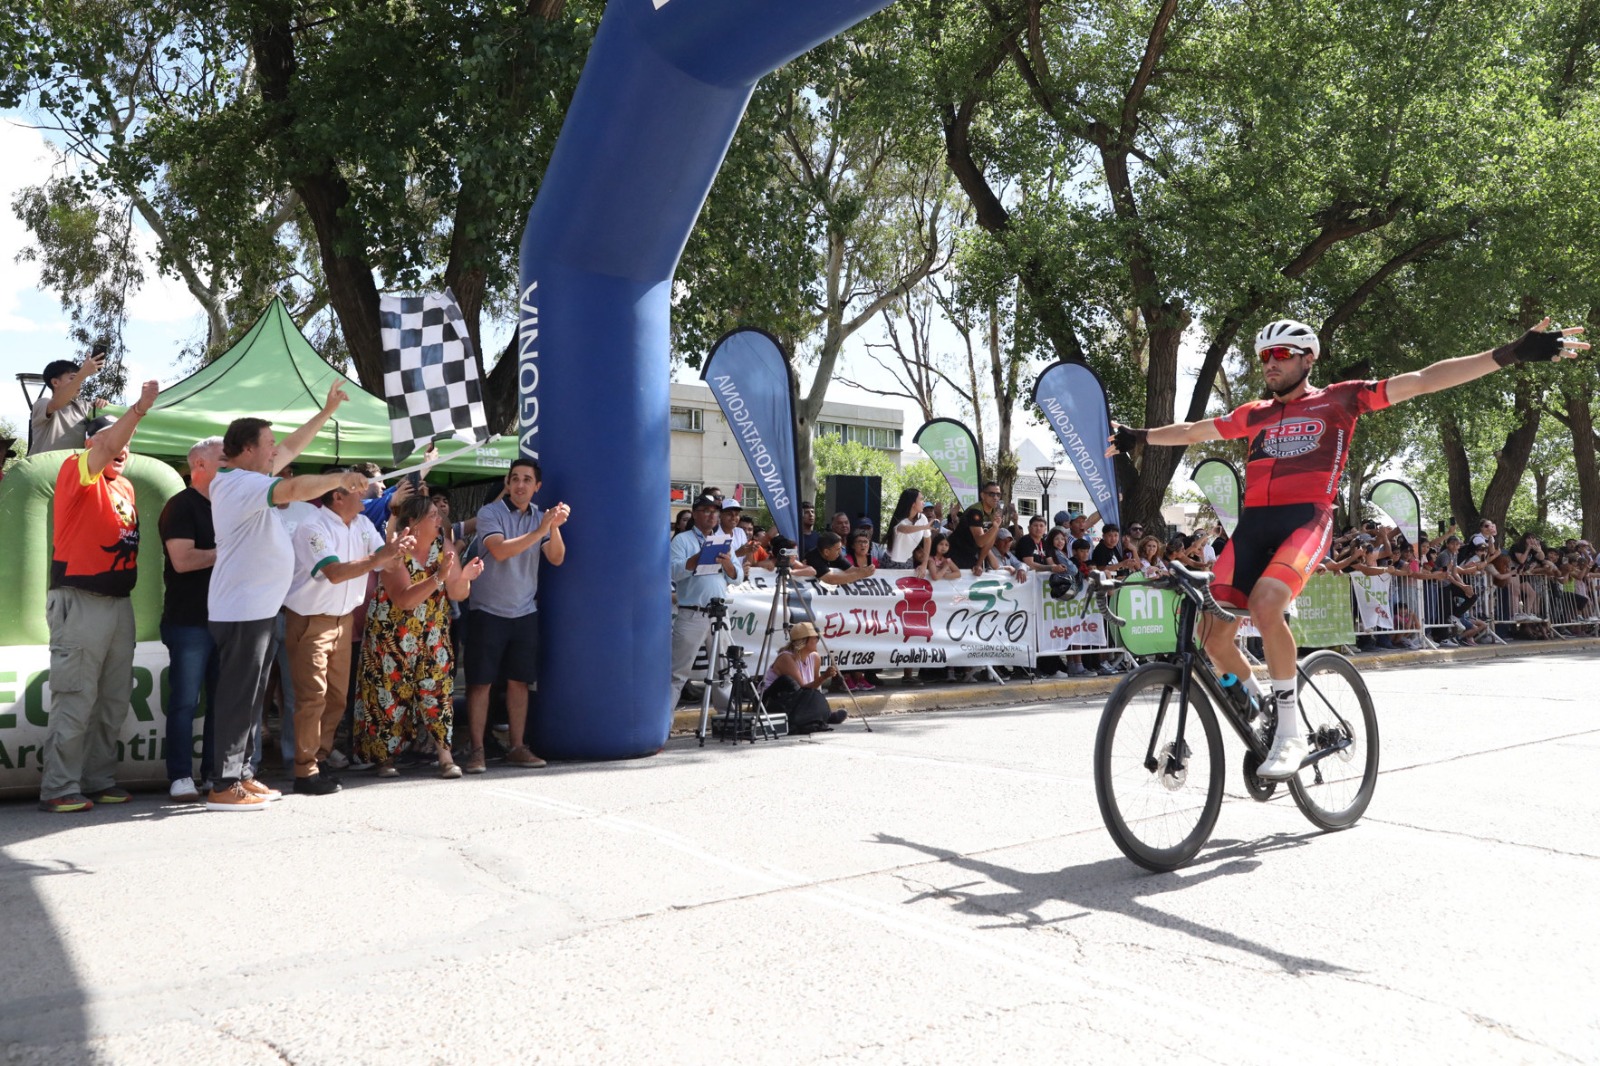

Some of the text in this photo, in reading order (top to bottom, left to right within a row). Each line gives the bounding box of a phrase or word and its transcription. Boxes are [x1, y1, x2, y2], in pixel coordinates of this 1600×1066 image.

[1264, 420, 1323, 440] RED
[1268, 435, 1314, 445] INTEGRAL
[1130, 589, 1163, 620] RN
[823, 608, 898, 639] EL TULA
[1050, 620, 1098, 640] depote
[852, 651, 875, 666] 1268
